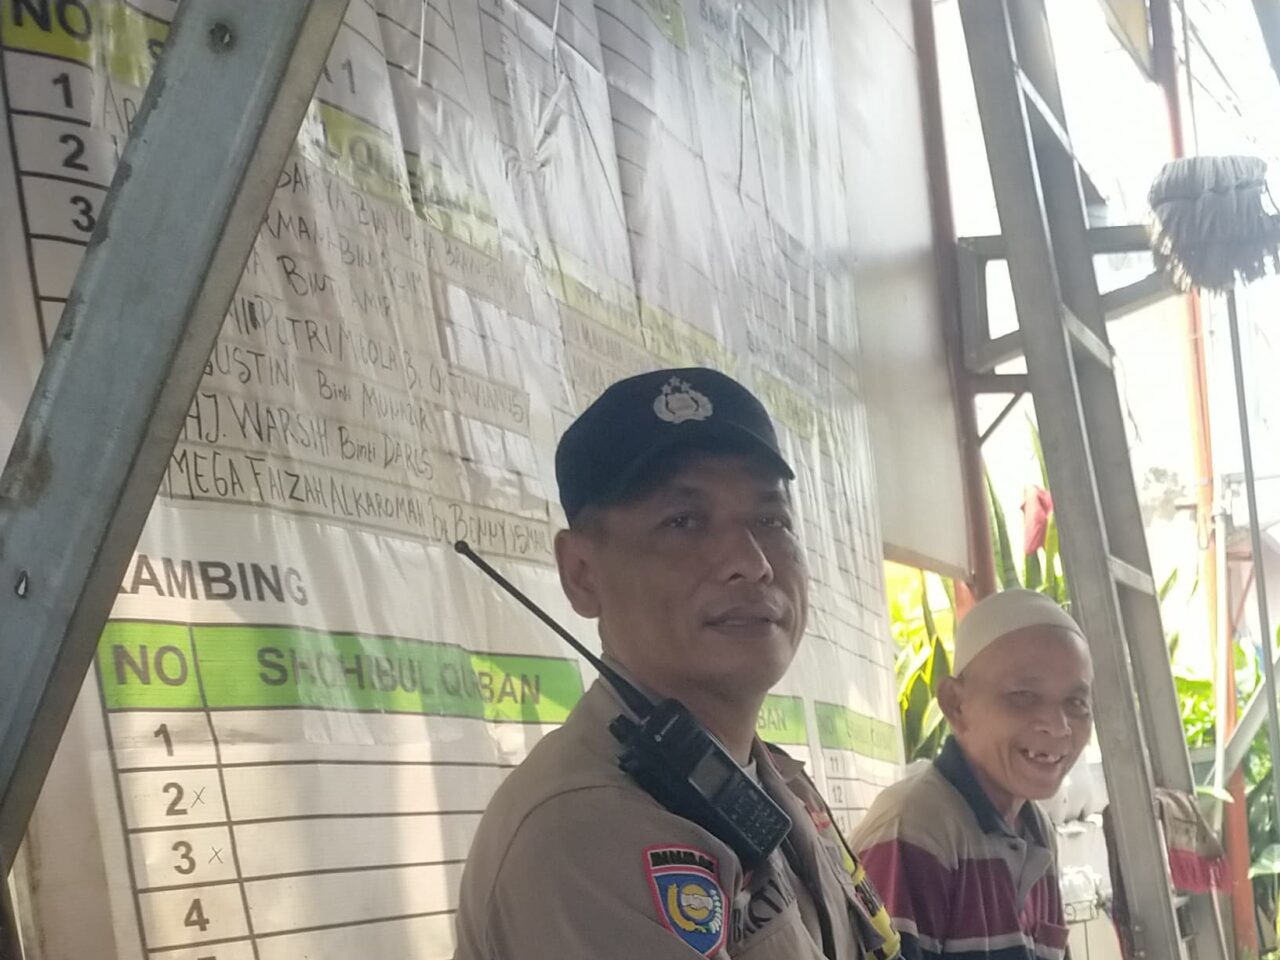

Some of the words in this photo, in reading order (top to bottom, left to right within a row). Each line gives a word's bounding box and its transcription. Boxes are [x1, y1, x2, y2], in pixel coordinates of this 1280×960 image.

[10, 0, 91, 41] NO
[52, 72, 74, 108] 1
[59, 133, 89, 171] 2
[69, 195, 96, 232] 3
[168, 448, 245, 500] MEGA
[115, 645, 188, 688] NO
[153, 723, 174, 757] 1
[162, 782, 188, 817] 2
[173, 840, 196, 875] 3
[184, 898, 210, 932] 4
